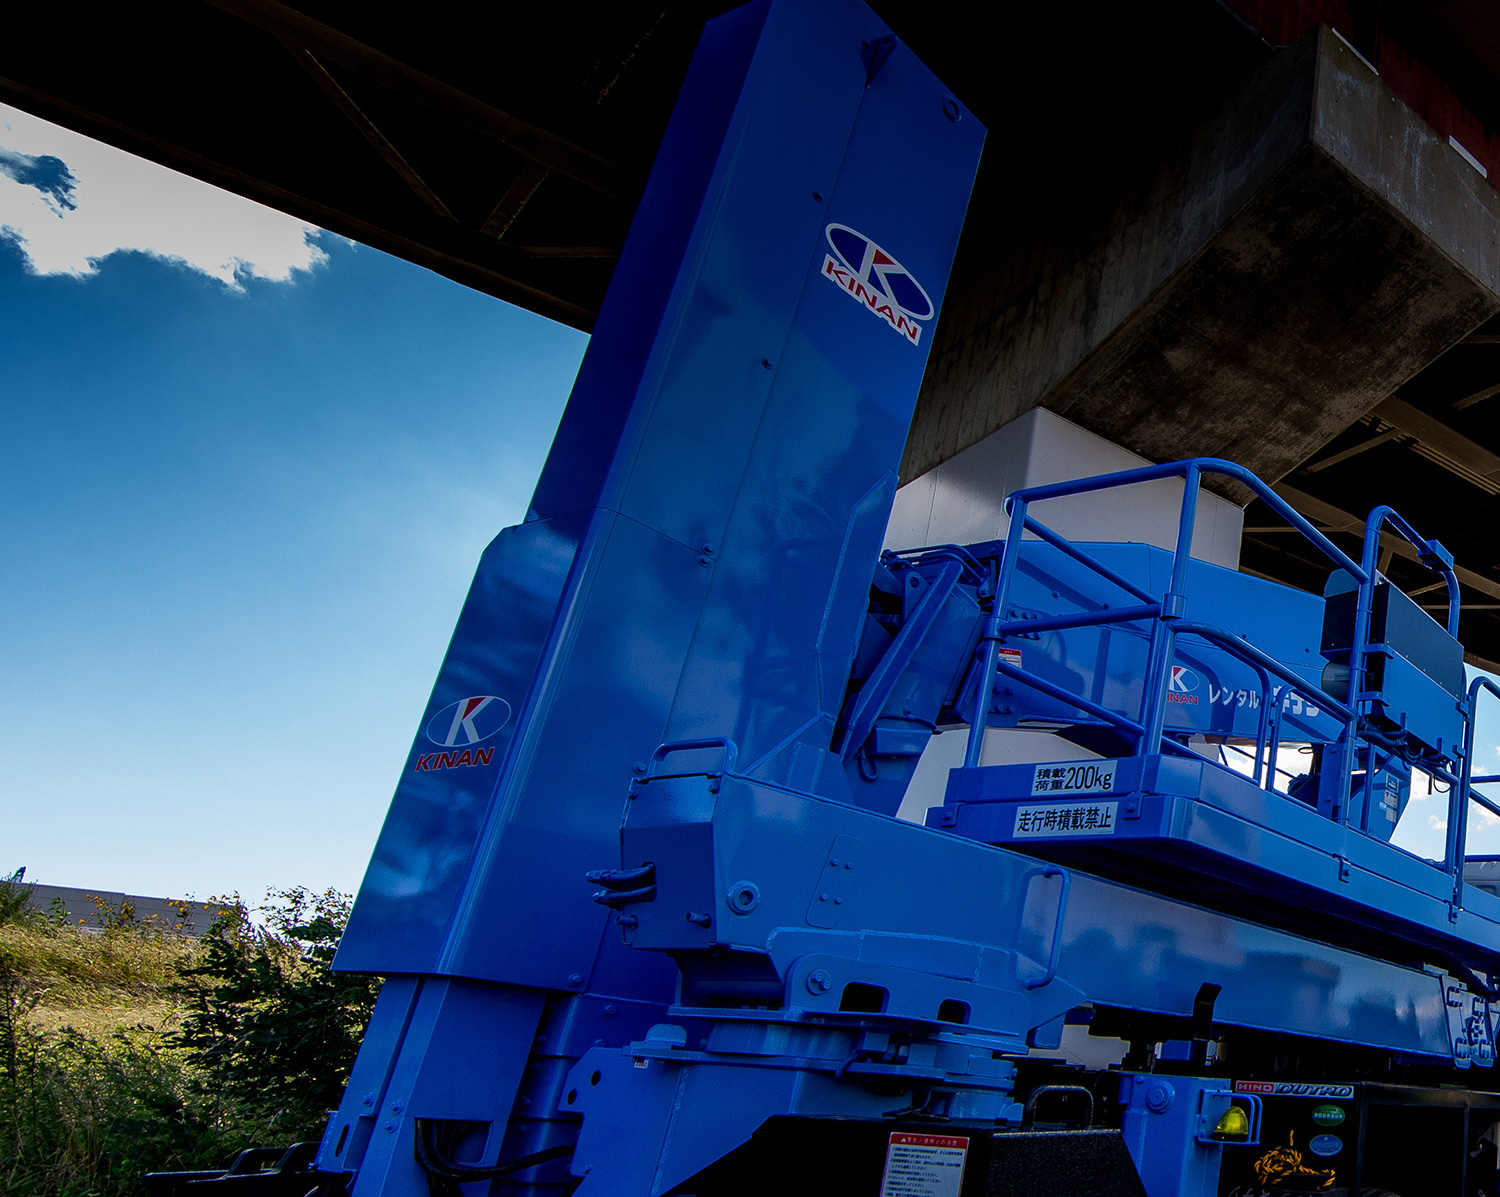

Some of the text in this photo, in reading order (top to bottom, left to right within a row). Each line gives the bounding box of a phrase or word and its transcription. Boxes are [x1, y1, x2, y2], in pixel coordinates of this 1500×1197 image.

[825, 258, 919, 342] KINAN
[1167, 692, 1198, 705] INAN
[1208, 683, 1260, 710] レンタル
[415, 747, 495, 772] KINAN
[1034, 779, 1065, 792] 荷重
[1036, 765, 1113, 790] 積載 200kg
[1017, 806, 1112, 833] 走行時積載禁止
[1237, 1082, 1353, 1098] HINO DUTRO
